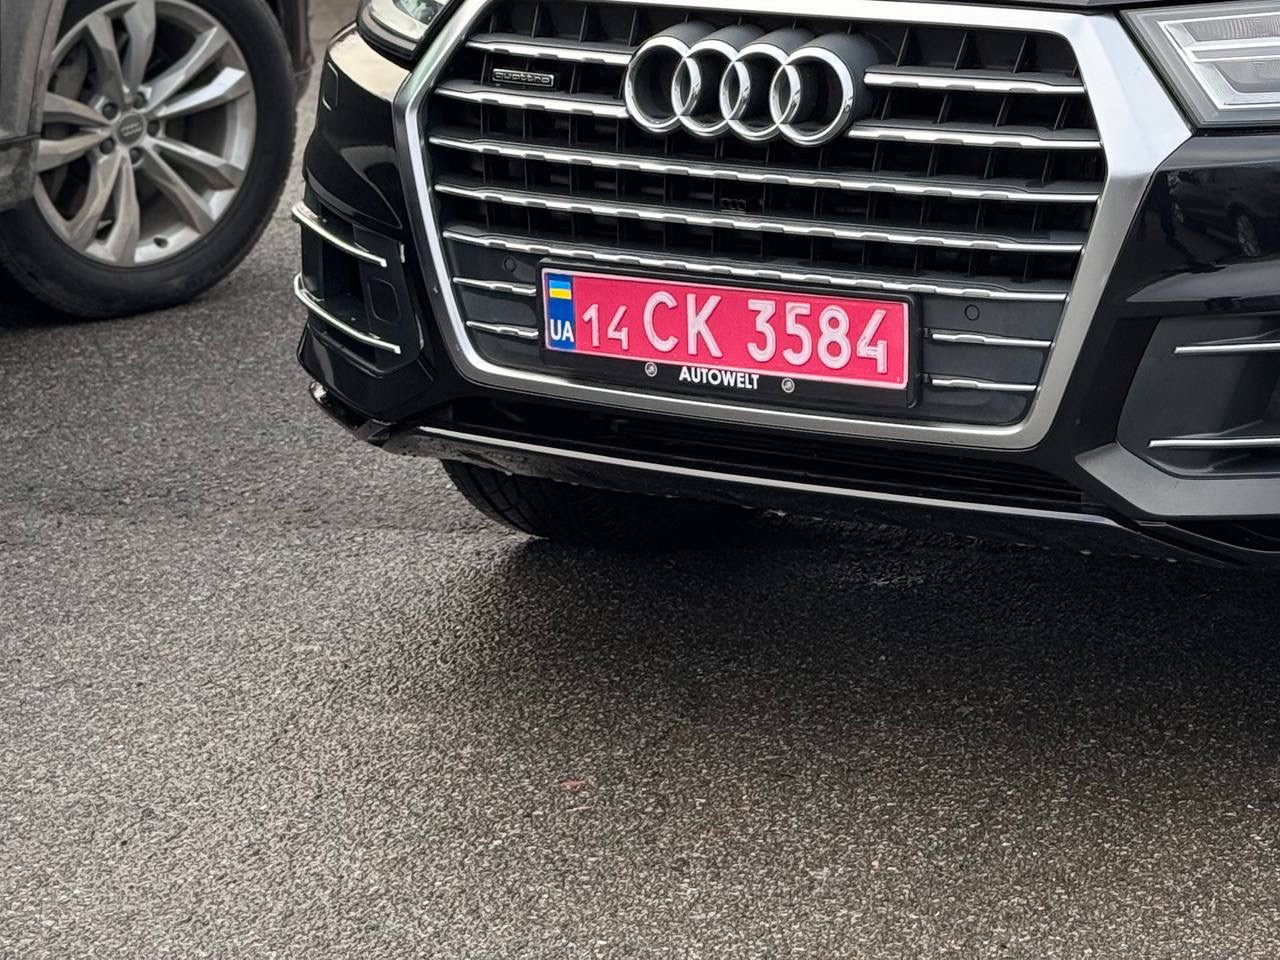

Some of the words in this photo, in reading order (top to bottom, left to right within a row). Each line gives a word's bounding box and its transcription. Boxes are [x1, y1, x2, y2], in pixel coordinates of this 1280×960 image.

[494, 71, 550, 84] quattro
[549, 318, 575, 343] UA
[746, 298, 888, 375] 3584
[678, 366, 760, 390] AUTOWELT
